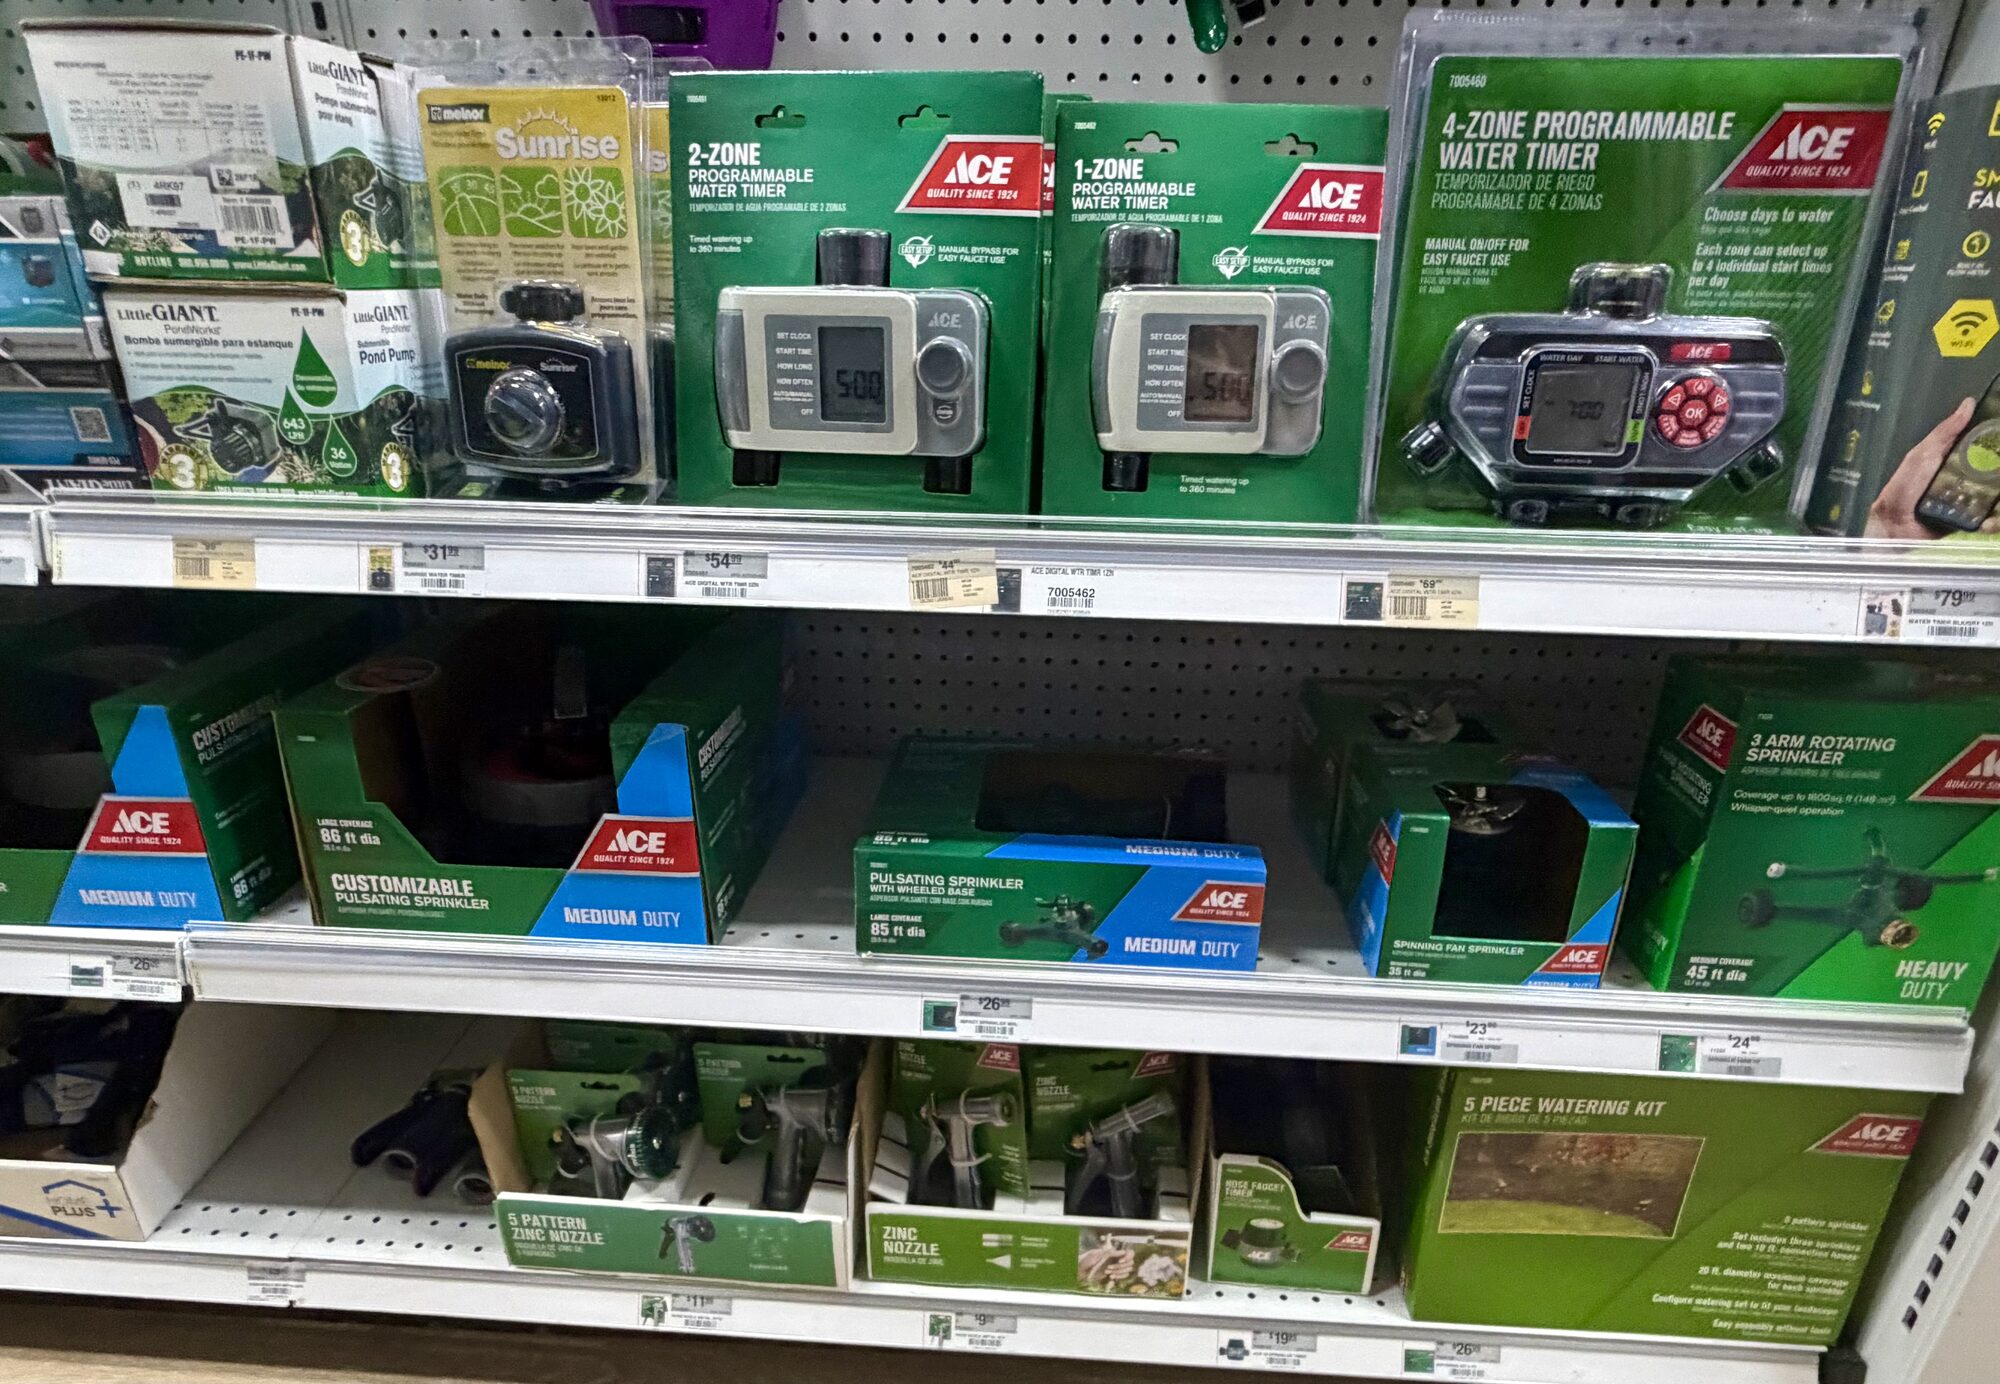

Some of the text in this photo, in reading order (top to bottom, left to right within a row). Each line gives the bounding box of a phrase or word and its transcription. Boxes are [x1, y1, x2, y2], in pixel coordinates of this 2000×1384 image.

[1442, 110, 1737, 142] 4-ZONE PROGRAMMABLE
[495, 127, 620, 160] Sunrise
[1768, 121, 1855, 161] ACE
[688, 142, 761, 166] 2-ZONE
[1439, 142, 1600, 171] WATER TIMER
[943, 151, 1014, 185] ACE
[1074, 157, 1144, 181] 1-ZONE
[1746, 165, 1851, 177] QUALITY SINCE 1924
[689, 169, 814, 183] PROGRAMMABLE
[689, 184, 787, 198] WATER TIMER
[926, 188, 1018, 200] QUALITY SINCE 1924
[1072, 182, 1196, 197] PROGRAMMABLE
[1299, 177, 1364, 210] ACE
[1072, 196, 1168, 210] WATER TIMER
[1282, 211, 1367, 224] QUALITY SINCE 1924
[1704, 206, 1835, 225] Choose days to water
[689, 235, 753, 245] Timed watering up
[1425, 238, 1530, 251] MANUAL ON/OFF FOR
[689, 245, 696, 253] to
[697, 245, 712, 253] 360
[938, 245, 1019, 256] MANUAL BYPASS FOR
[1695, 243, 1829, 259] Each zone can select up
[938, 254, 1006, 264] EASY FAUCET USE
[1253, 257, 1334, 267] MANUAL BYPASS FOR
[1423, 253, 1511, 266] EASY FAUCET USE
[1692, 259, 1833, 274] to 4 individual start times
[1252, 265, 1321, 275] EASY FAUCET USE
[1688, 274, 1730, 288] per day
[124, 335, 294, 350] Bomba sumergible para estanque
[776, 332, 812, 340] SET CLOCK
[1150, 333, 1187, 341] SET CLOCK
[359, 347, 416, 365] Pond Pump
[1686, 346, 1713, 358] ACE
[801, 408, 814, 416] OFF
[1167, 410, 1181, 418] OFF
[1685, 408, 1704, 418] OK
[283, 417, 305, 429] 643
[331, 448, 347, 459] 36
[1180, 476, 1249, 487] Timed watering up
[1031, 566, 1045, 575] ACE
[1045, 567, 1070, 576] DIGITAL
[1047, 586, 1096, 598] 7005462
[1750, 734, 1897, 752] 3 ARM ROTATING
[1745, 748, 1846, 766] SPRINKLER
[1731, 802, 1845, 816] Whisper-quiet operation
[111, 808, 171, 834] ACE
[320, 828, 381, 846] 86 ft dia
[607, 827, 667, 854] ACE
[593, 854, 675, 865] QUALITY SINCE 1924
[331, 873, 474, 897] CUSTOMIZABLE
[870, 872, 1024, 890] PULSATING SPRINKLER
[870, 884, 975, 897] WITH WHEELED BASE
[78, 889, 197, 908] MEDIUM DUTY
[335, 892, 490, 910] PULSATING SPRINKLER
[1200, 889, 1249, 909] ACE
[563, 906, 681, 928] MEDIUM DUTY
[870, 913, 922, 923] LARGE COVERAGE
[870, 923, 926, 938] 85 ft dia
[1124, 936, 1241, 959] MEDIUM DUTY
[1393, 940, 1525, 956] SPINNING FAN SPRINKLER
[1561, 948, 1599, 963] ACE
[1388, 966, 1426, 978] 35 ft dia
[1685, 965, 1747, 982] 45 ft dia
[1894, 959, 1969, 980] HEAVY
[1899, 980, 1950, 1000] DUTY
[990, 1049, 1012, 1062] ACE
[1036, 1084, 1070, 1096] NOZZLE
[1463, 1096, 1667, 1117] 5 PIECE WATERING KIT
[1849, 1122, 1911, 1143] ACE
[1225, 1180, 1286, 1193] HOSE FAUCET
[51, 1205, 96, 1218] PLUS
[508, 1213, 587, 1231] 5 PATTERN
[511, 1227, 605, 1246] ZINC NOZZLE
[883, 1226, 918, 1242] ZINC
[1342, 1235, 1368, 1246] ACE
[883, 1241, 940, 1257] NOZZLE
[1247, 1250, 1272, 1261] ACE
